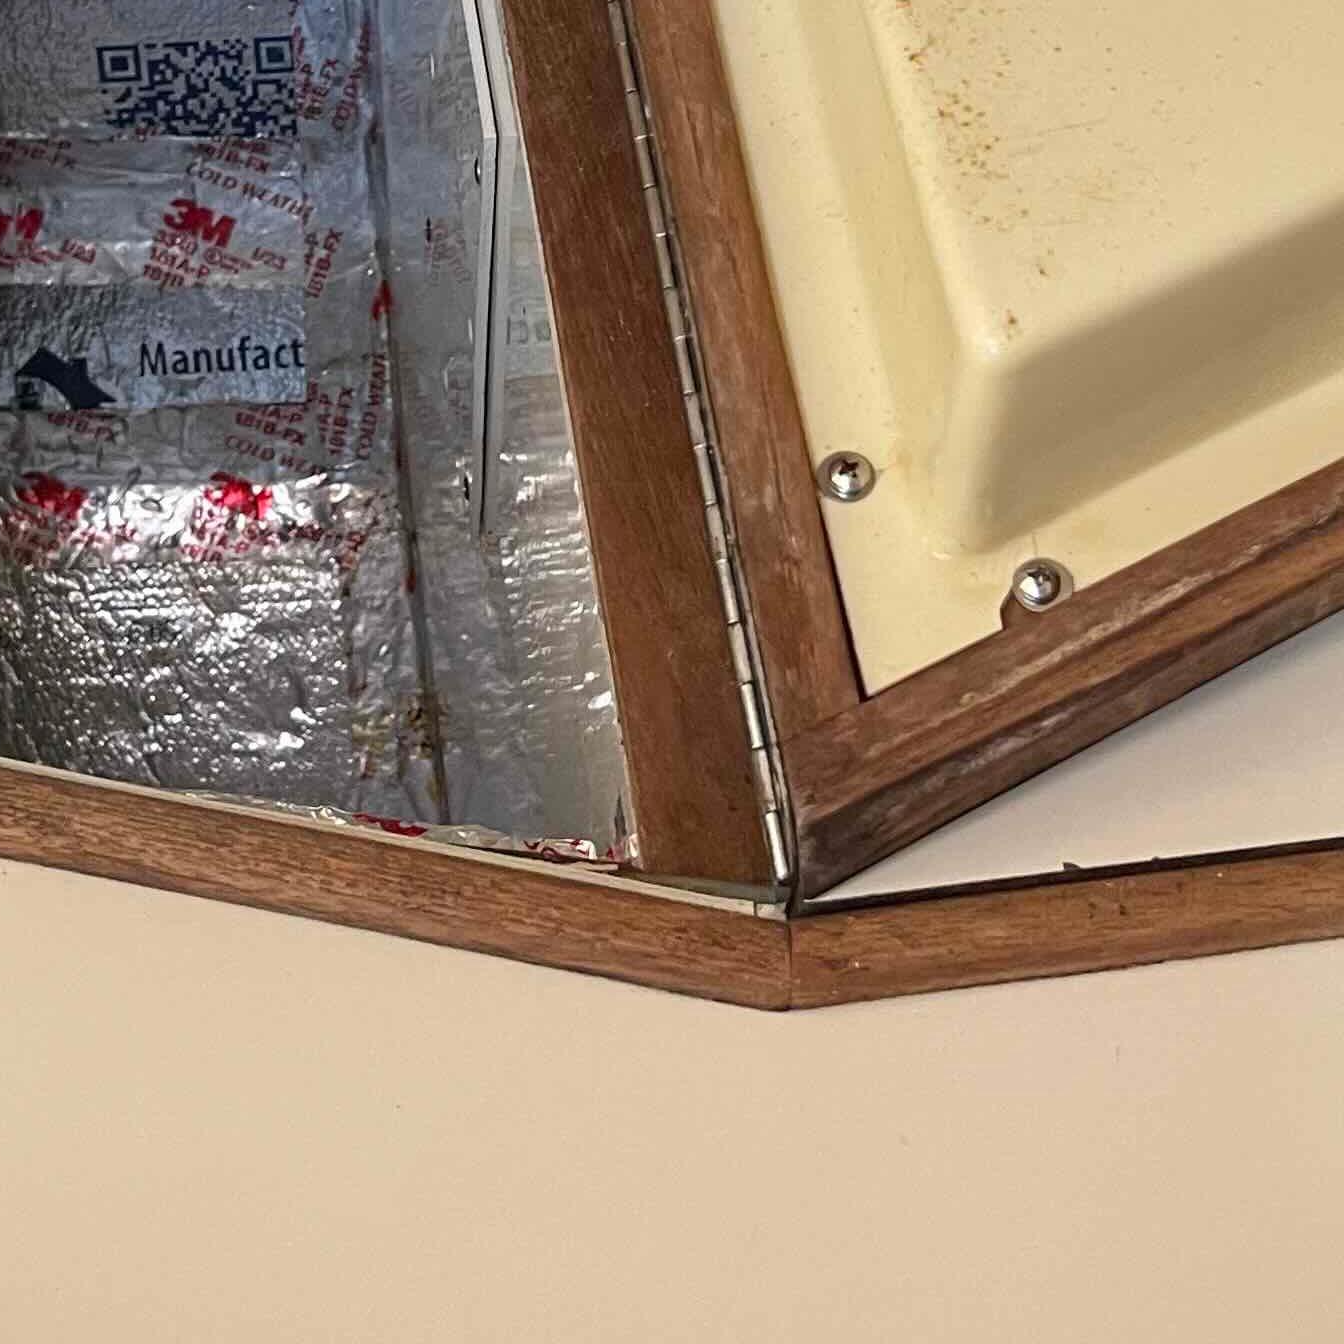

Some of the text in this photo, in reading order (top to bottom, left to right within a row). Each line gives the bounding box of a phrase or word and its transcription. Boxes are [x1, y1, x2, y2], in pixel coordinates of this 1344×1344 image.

[186, 162, 237, 189] COLD
[163, 198, 236, 248] 3M
[139, 335, 305, 377] Manufact
[224, 435, 275, 461] COLD
[359, 410, 377, 459] COLD
